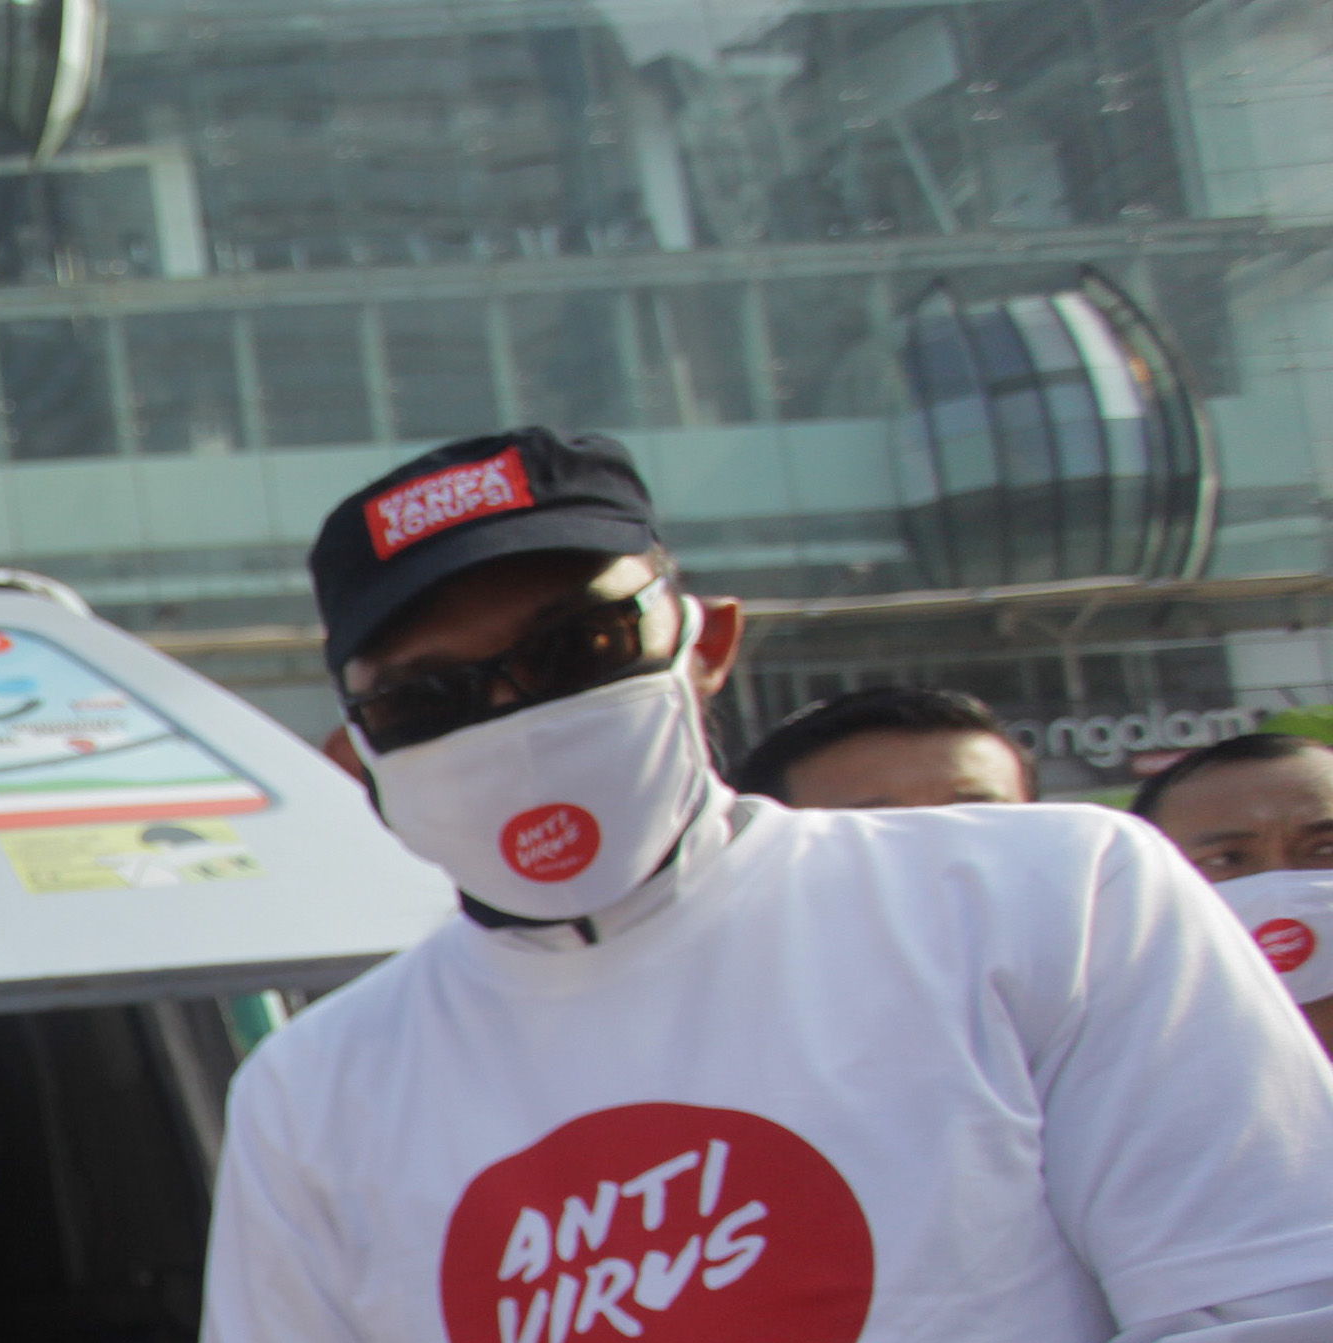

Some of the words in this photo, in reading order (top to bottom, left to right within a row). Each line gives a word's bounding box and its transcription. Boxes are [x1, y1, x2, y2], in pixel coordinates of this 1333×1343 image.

[384, 486, 512, 547] KORUPSI
[385, 472, 514, 528] TANPA
[496, 1137, 730, 1283] ANTI
